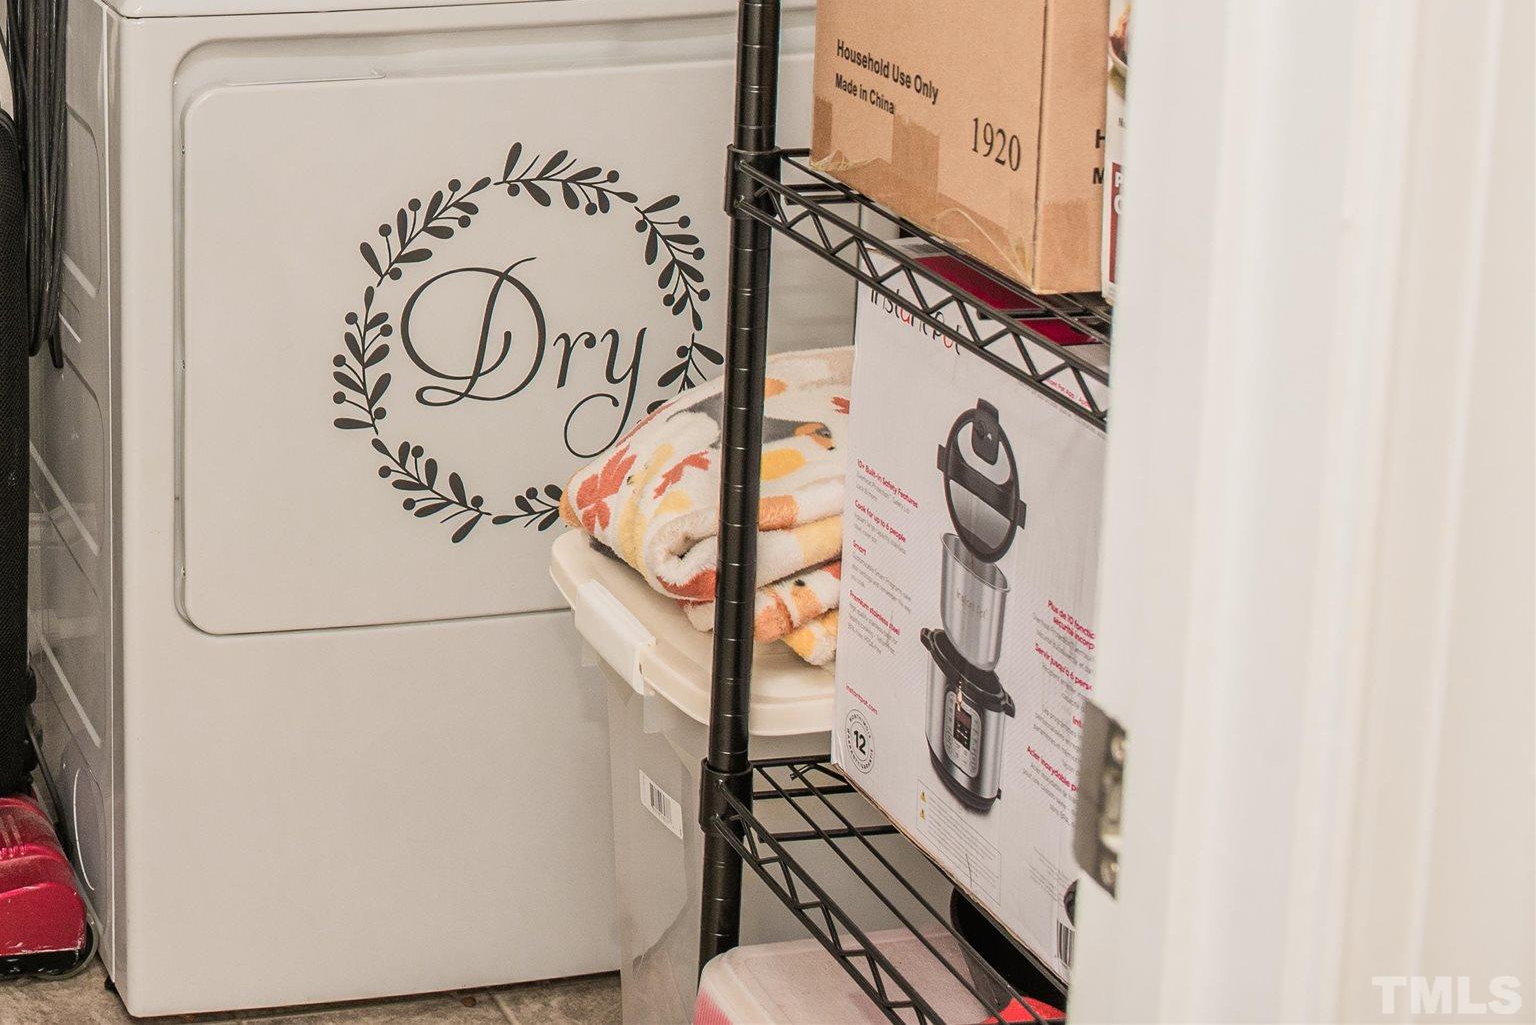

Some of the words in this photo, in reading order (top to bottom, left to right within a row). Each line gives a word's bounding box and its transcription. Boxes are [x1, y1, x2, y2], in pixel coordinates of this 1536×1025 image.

[836, 39, 890, 79] Household
[892, 63, 912, 89] Use
[914, 75, 939, 105] Only
[836, 73, 858, 96] Made
[860, 84, 868, 101] in
[870, 89, 895, 115] China
[972, 117, 1021, 172] 1920
[400, 256, 648, 459] Dry
[883, 477, 898, 495] Safety
[898, 488, 918, 508] Features
[855, 499, 866, 513] Cook
[874, 516, 880, 525] up
[881, 519, 886, 528] to
[890, 527, 906, 543] people
[850, 589, 869, 611] Premium
[1048, 599, 1059, 614] Plus
[1059, 610, 1066, 620] de
[854, 730, 866, 756] 12
